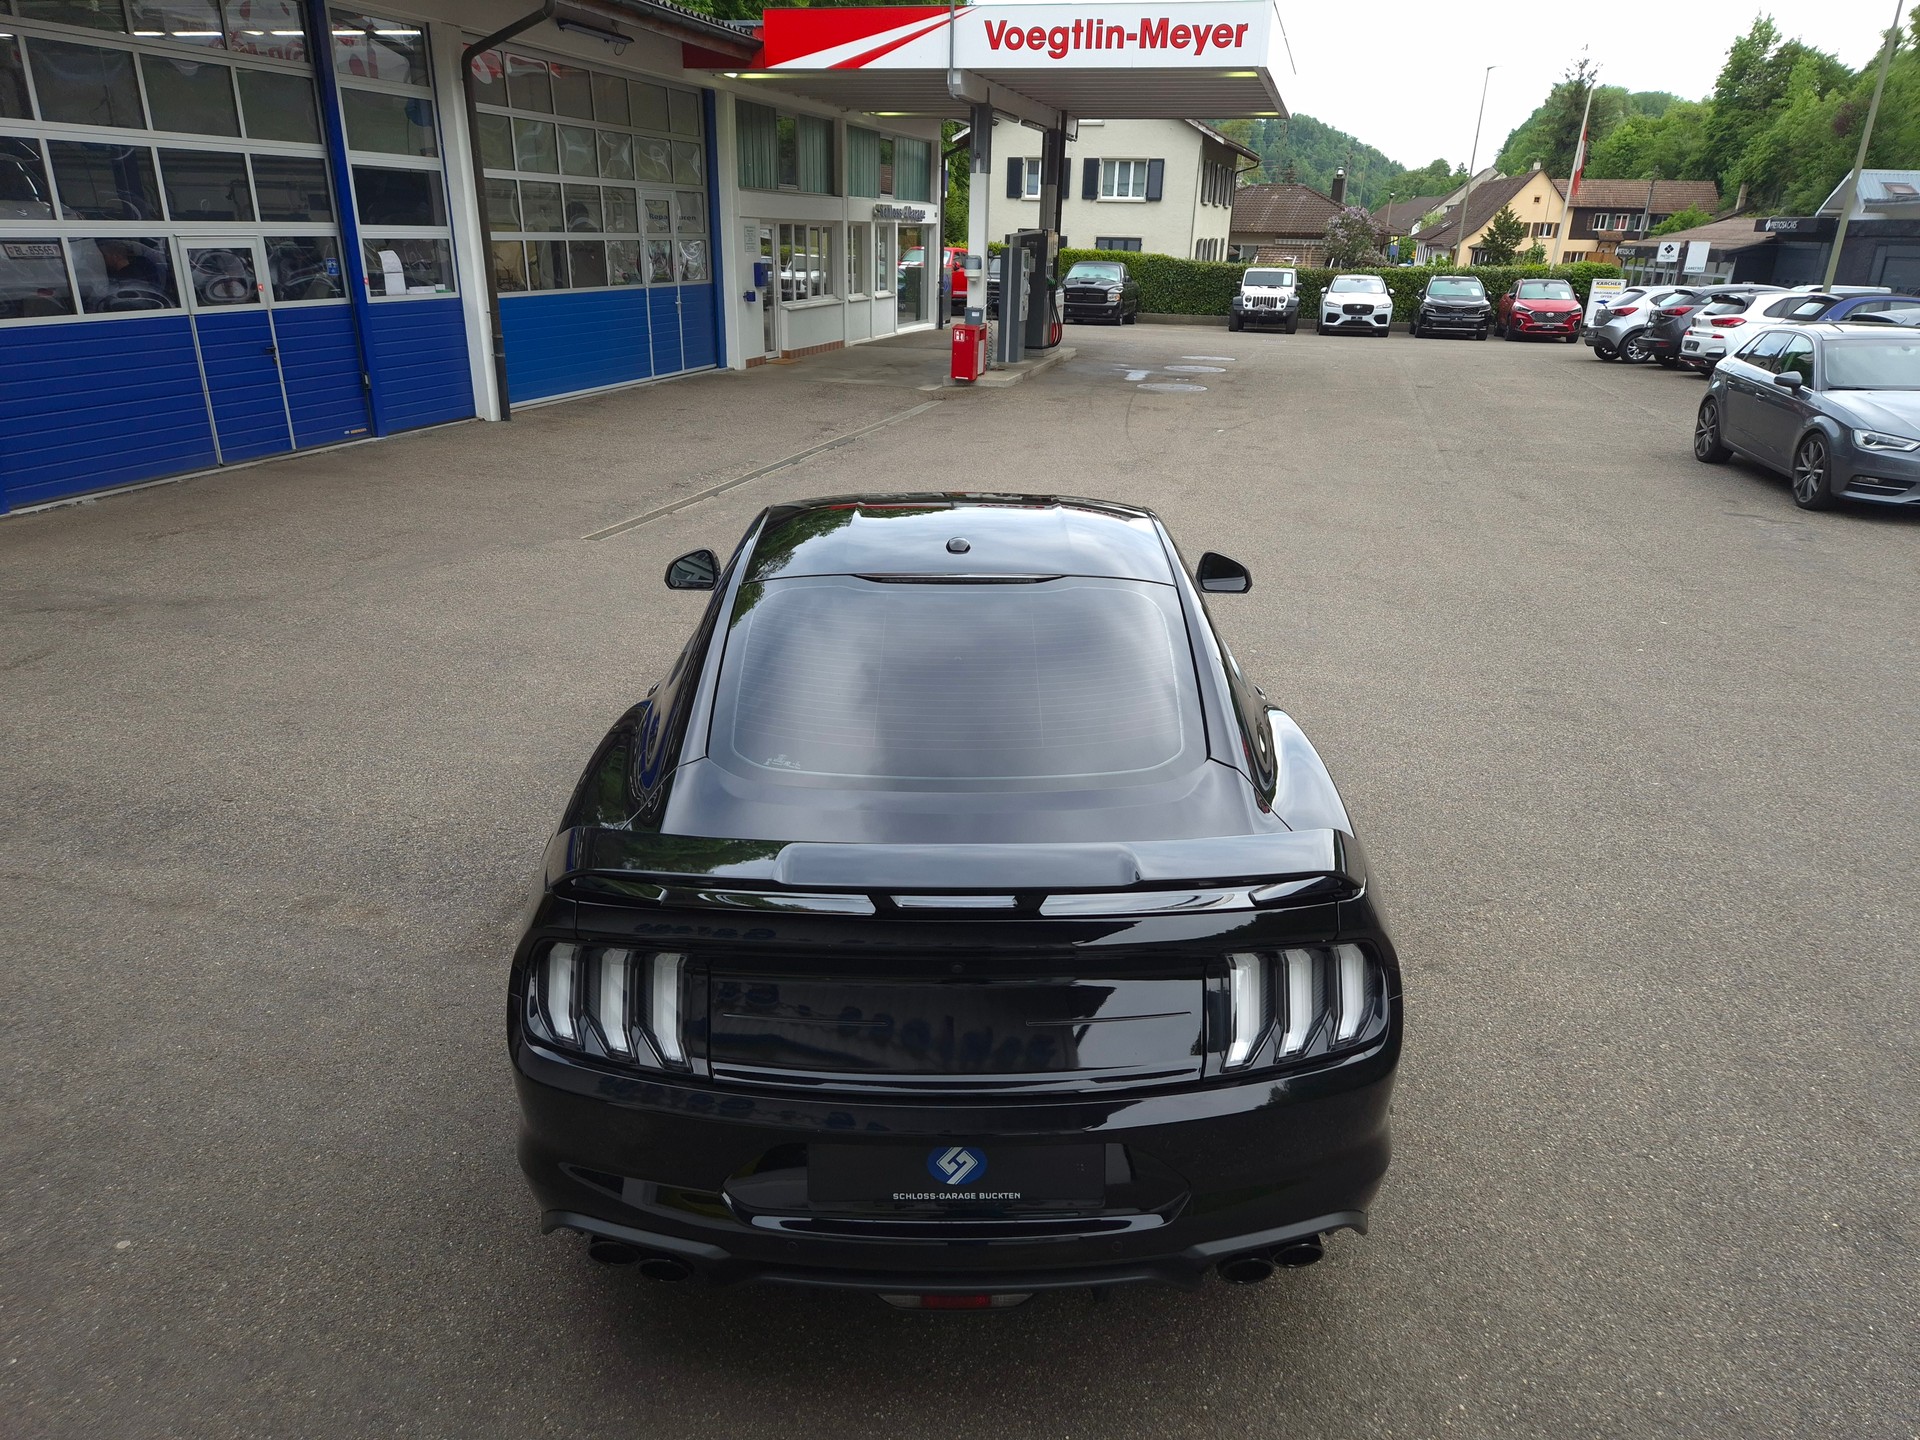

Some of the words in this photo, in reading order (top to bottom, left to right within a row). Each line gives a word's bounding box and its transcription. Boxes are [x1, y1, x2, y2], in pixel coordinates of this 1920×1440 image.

[984, 17, 1249, 60] Voegtlin-Meyer
[892, 1192, 977, 1201] SCHLOSS-GARAGE
[979, 1192, 1021, 1200] BUCKTEN
